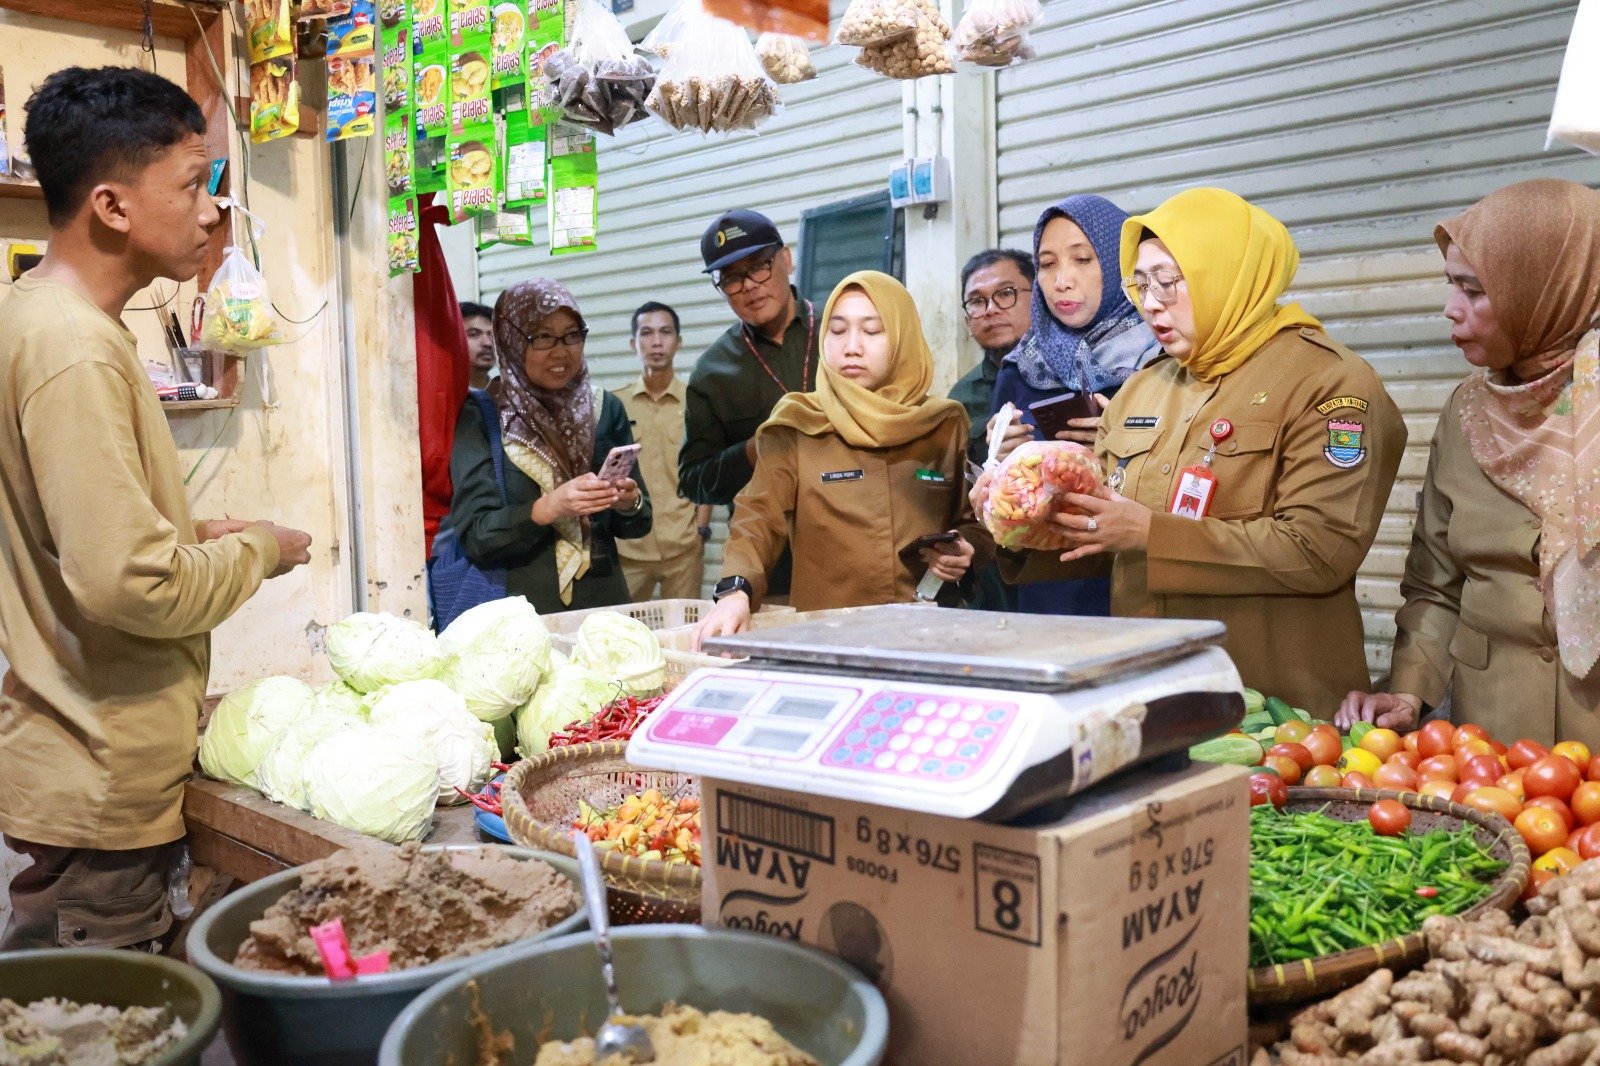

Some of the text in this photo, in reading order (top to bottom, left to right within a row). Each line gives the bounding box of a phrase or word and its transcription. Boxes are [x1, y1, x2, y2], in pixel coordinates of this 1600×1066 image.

[716, 836, 811, 890] AYAM
[846, 855, 898, 884] FOODS
[915, 838, 962, 874] 576
[1181, 837, 1215, 874] 576
[992, 879, 1021, 931] 8
[1121, 878, 1204, 951] AYAM
[1123, 949, 1199, 1041] Royco
